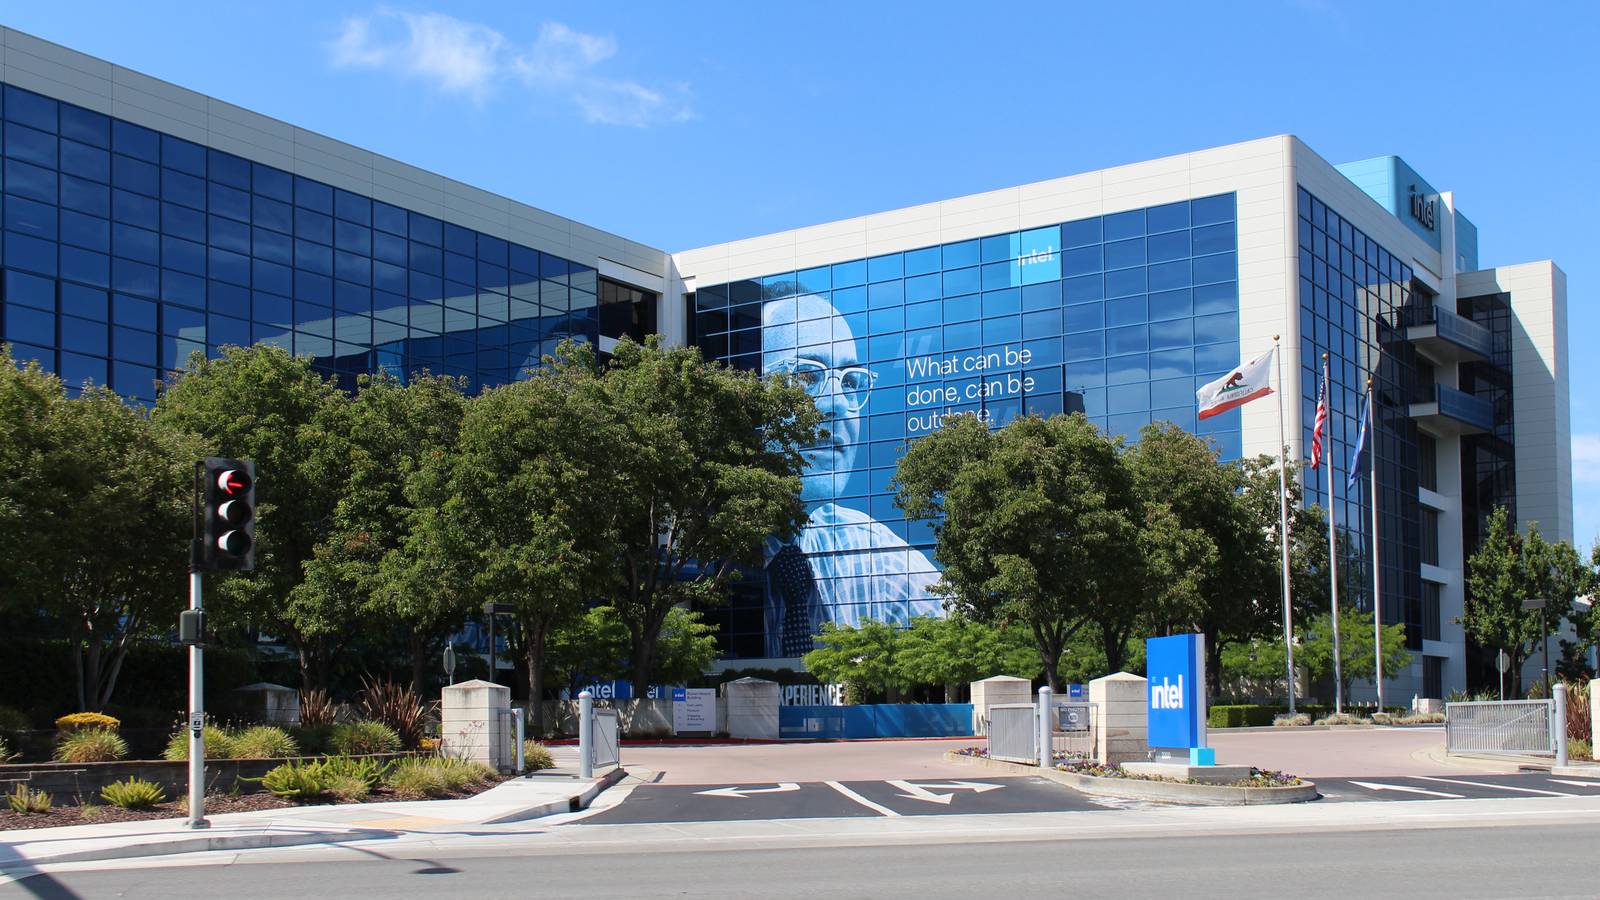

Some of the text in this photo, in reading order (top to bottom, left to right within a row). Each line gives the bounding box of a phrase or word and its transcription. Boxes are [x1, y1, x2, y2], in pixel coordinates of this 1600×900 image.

[1408, 184, 1434, 231] intel
[907, 345, 1032, 379] What can be
[907, 373, 1035, 406] done, can be
[583, 680, 616, 699] ntel
[778, 684, 843, 706] XPERIENCE
[1151, 674, 1184, 709] intel
